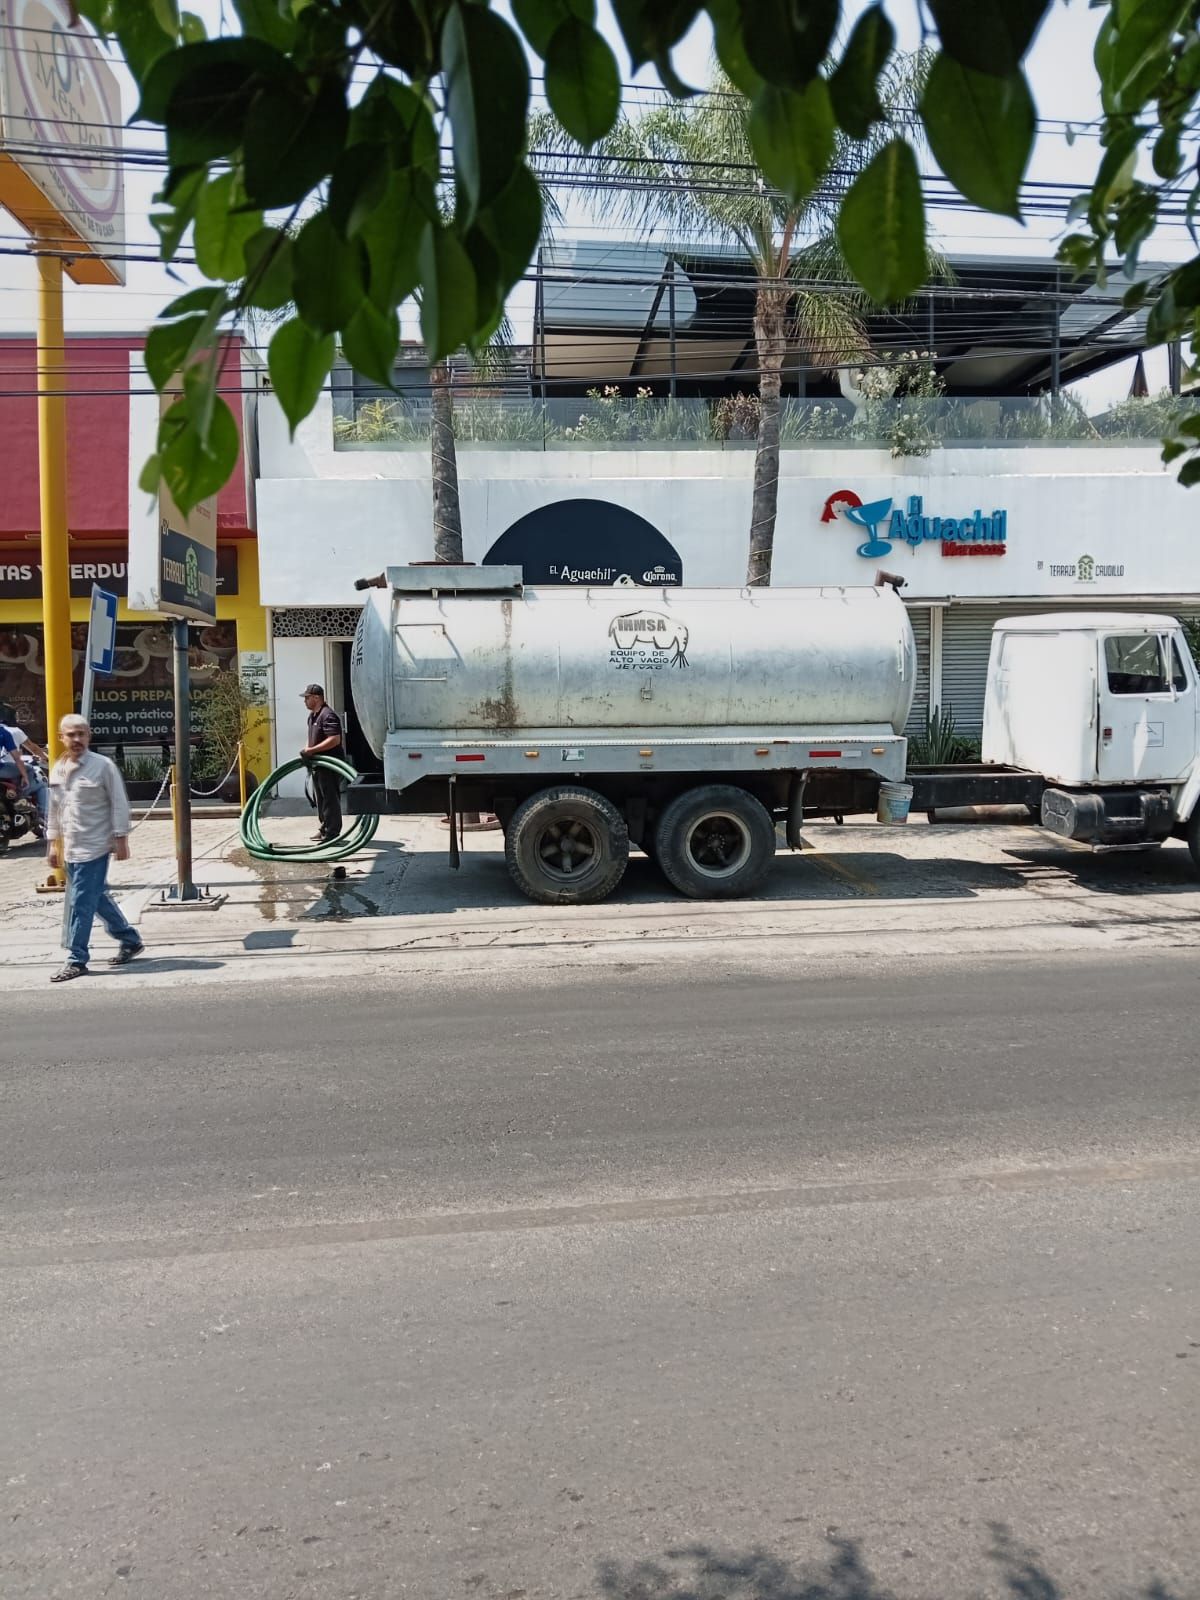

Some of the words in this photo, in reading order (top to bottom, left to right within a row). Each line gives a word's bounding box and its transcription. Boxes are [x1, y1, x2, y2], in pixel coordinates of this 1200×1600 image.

[68, 562, 129, 580] ERDU
[560, 565, 612, 583] Aguachil
[642, 571, 677, 583] Corona
[113, 726, 129, 735] un
[132, 723, 169, 737] toque
